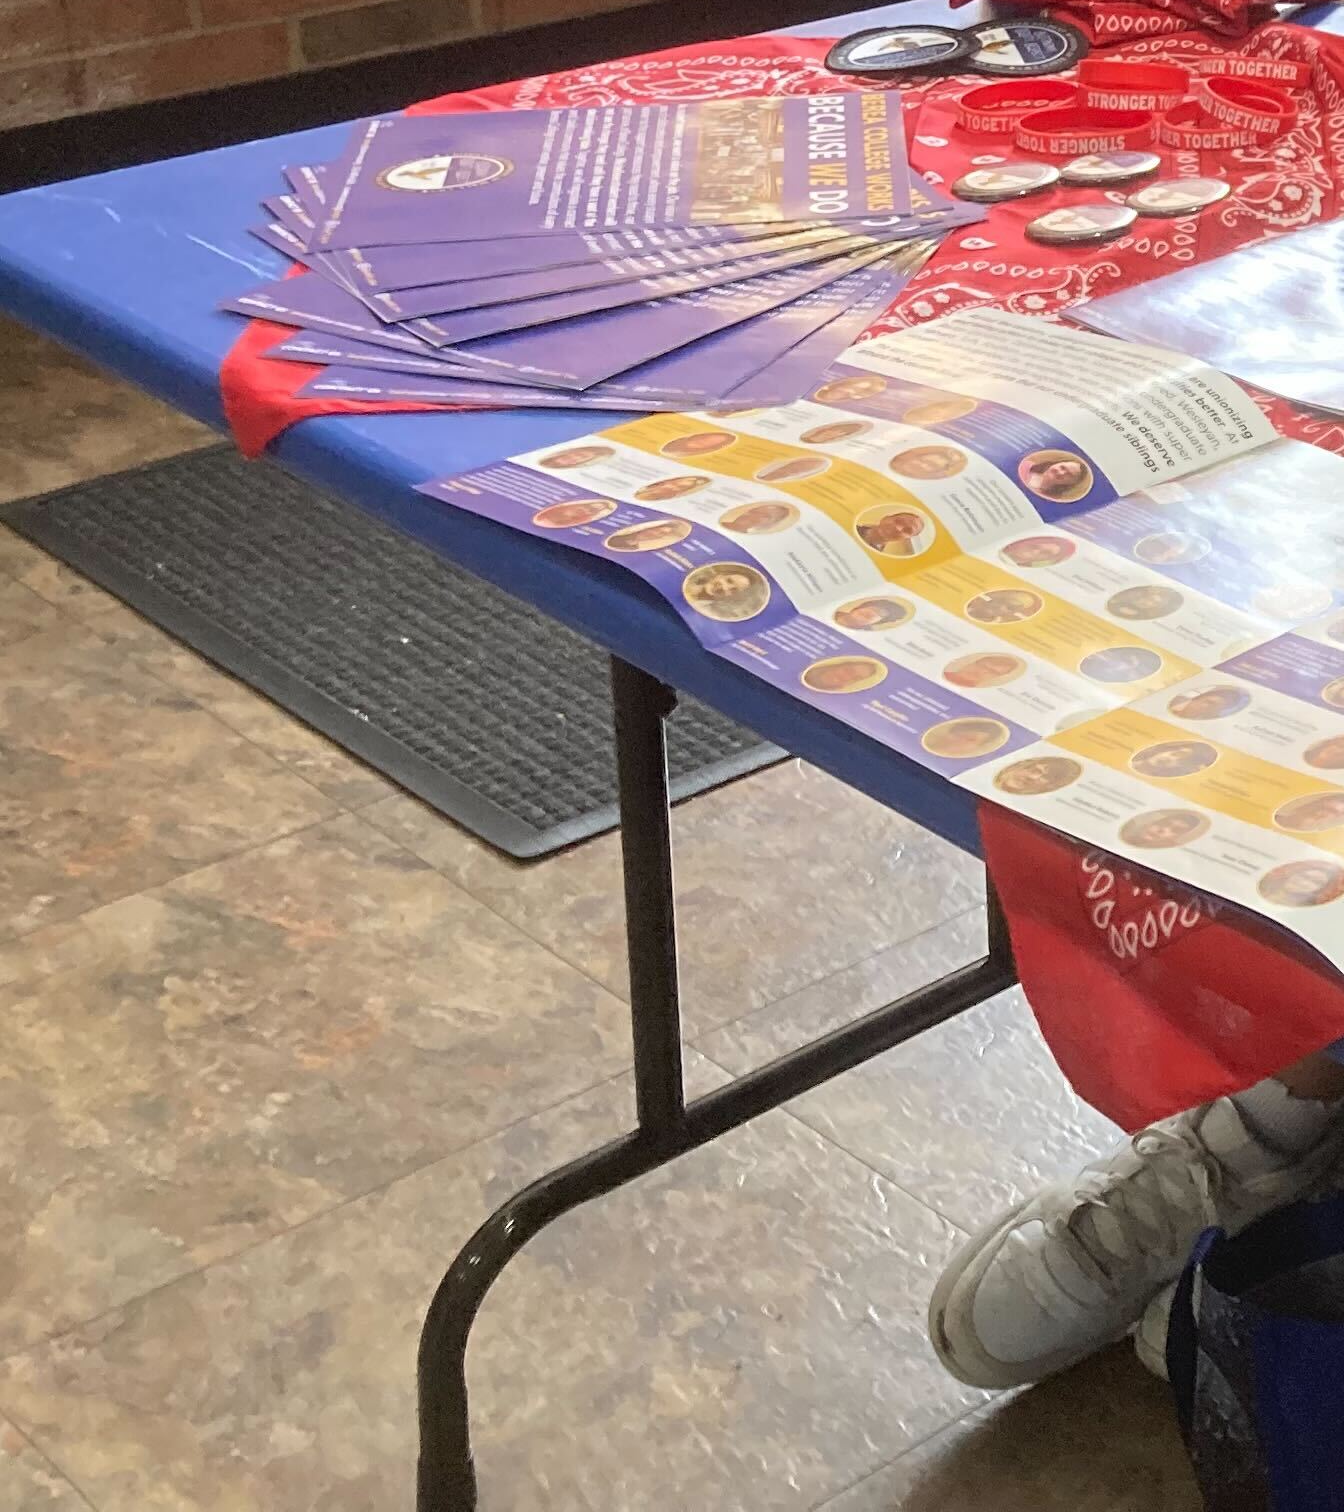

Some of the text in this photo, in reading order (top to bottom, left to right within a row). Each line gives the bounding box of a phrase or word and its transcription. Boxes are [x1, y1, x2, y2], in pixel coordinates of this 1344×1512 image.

[1228, 59, 1298, 80] TOGETHER
[1087, 92, 1156, 111] STRONGER
[1213, 100, 1280, 134] TOGETHER
[807, 95, 849, 214] BECAUSE WE DO
[861, 93, 894, 211] BEREA COLLEGE WORKS
[1049, 135, 1126, 155] STRONGER
[1183, 130, 1257, 149] TOGETHER
[1188, 376, 1254, 439] are unionizing
[1121, 410, 1176, 468] We deserve
[1123, 432, 1161, 473] siblings
[1143, 409, 1193, 462] with super
[1225, 432, 1240, 445] At
